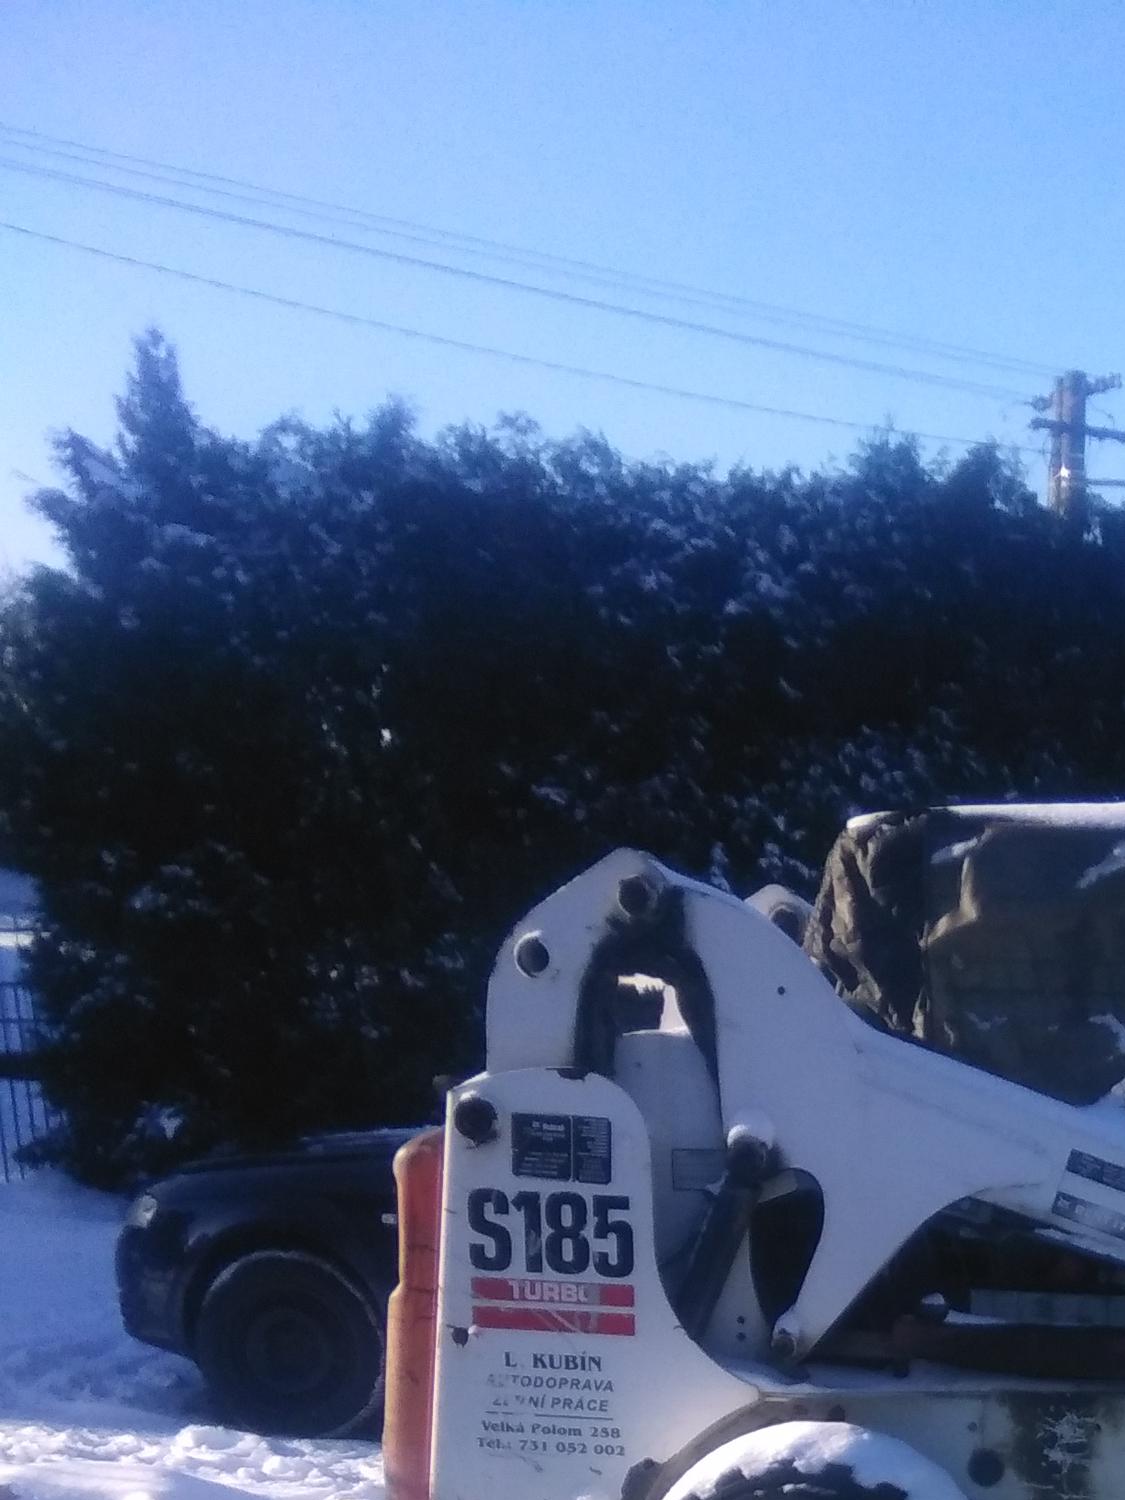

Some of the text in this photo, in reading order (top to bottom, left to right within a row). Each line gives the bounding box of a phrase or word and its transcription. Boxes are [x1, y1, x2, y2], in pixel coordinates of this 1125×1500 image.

[467, 1187, 635, 1279] S185
[532, 1351, 603, 1372] KUBÍN
[487, 1373, 615, 1393] ATODOPRAVA
[550, 1395, 609, 1413] PRÁCE
[530, 1422, 583, 1437] Polom
[518, 1439, 548, 1452] 731
[593, 1444, 626, 1457] 002
